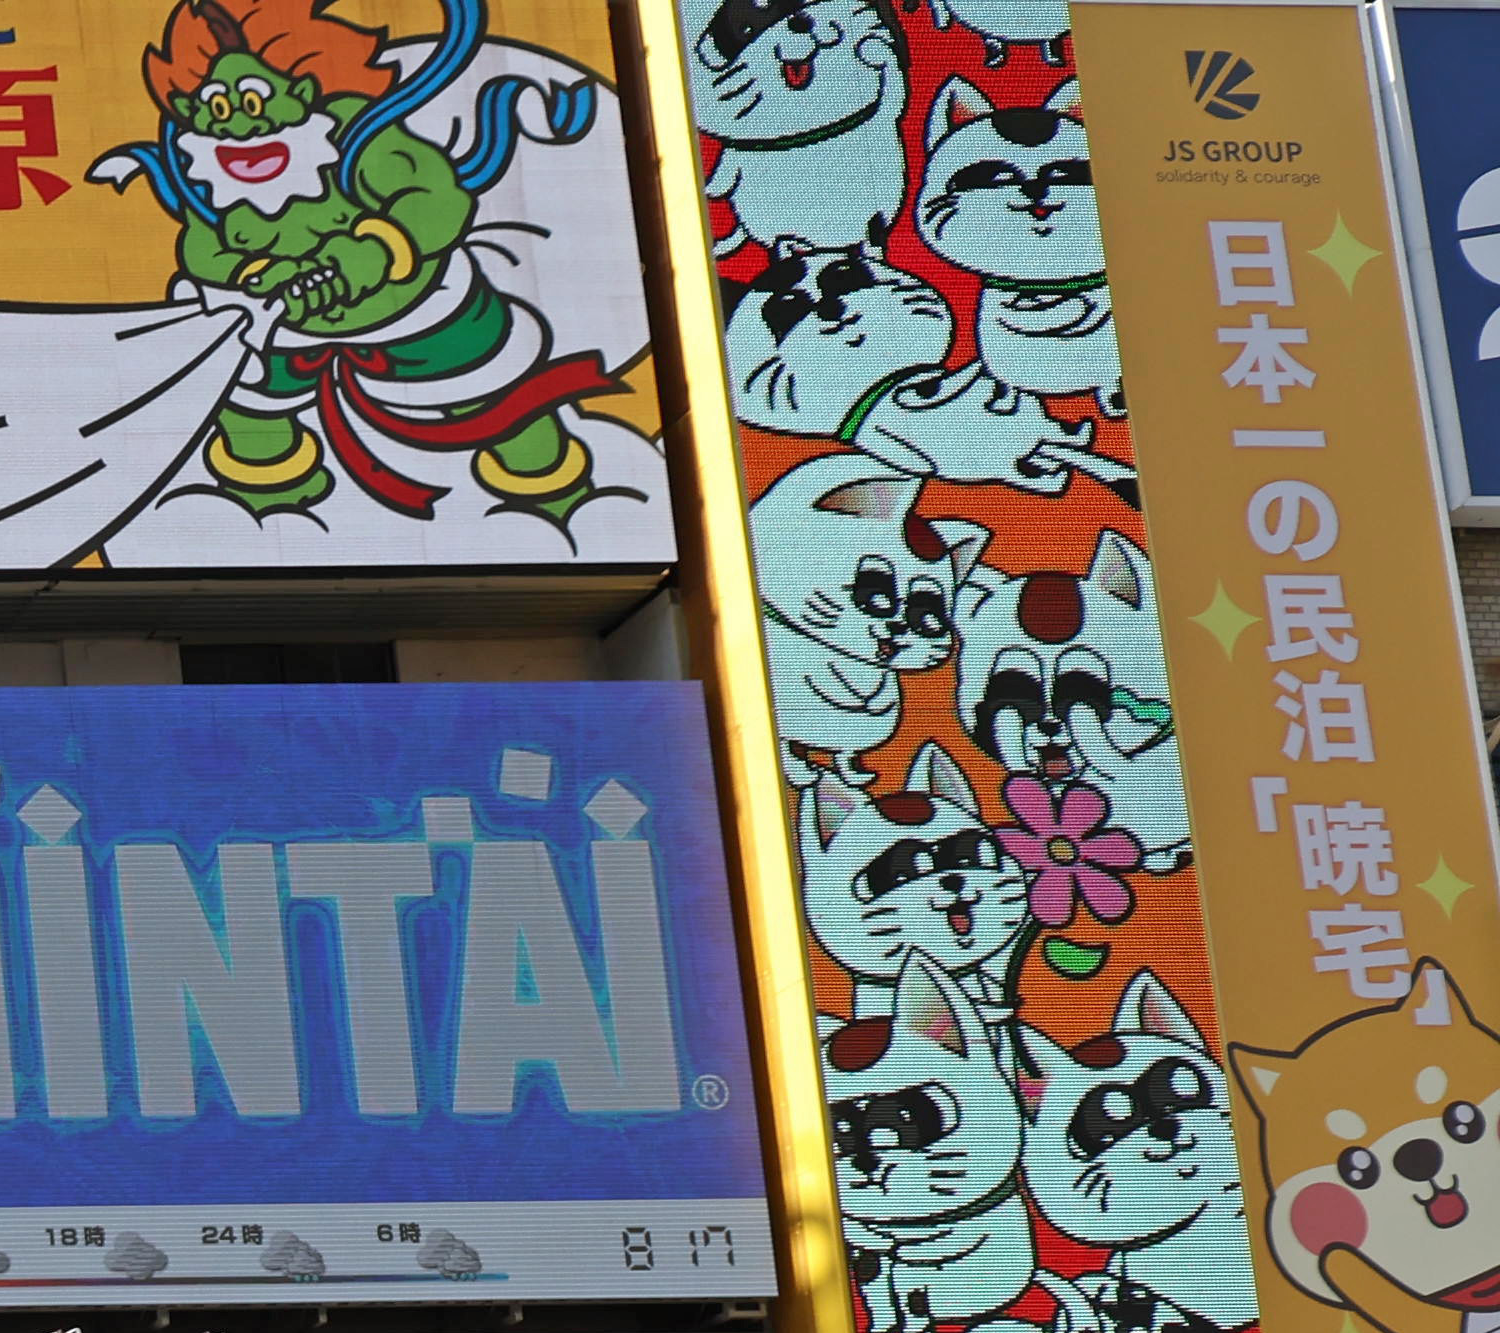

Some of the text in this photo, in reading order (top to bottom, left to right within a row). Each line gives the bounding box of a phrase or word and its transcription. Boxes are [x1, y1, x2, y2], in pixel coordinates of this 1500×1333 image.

[1164, 140, 1303, 163] JS GROUP
[1156, 168, 1321, 187] solidarity & courage
